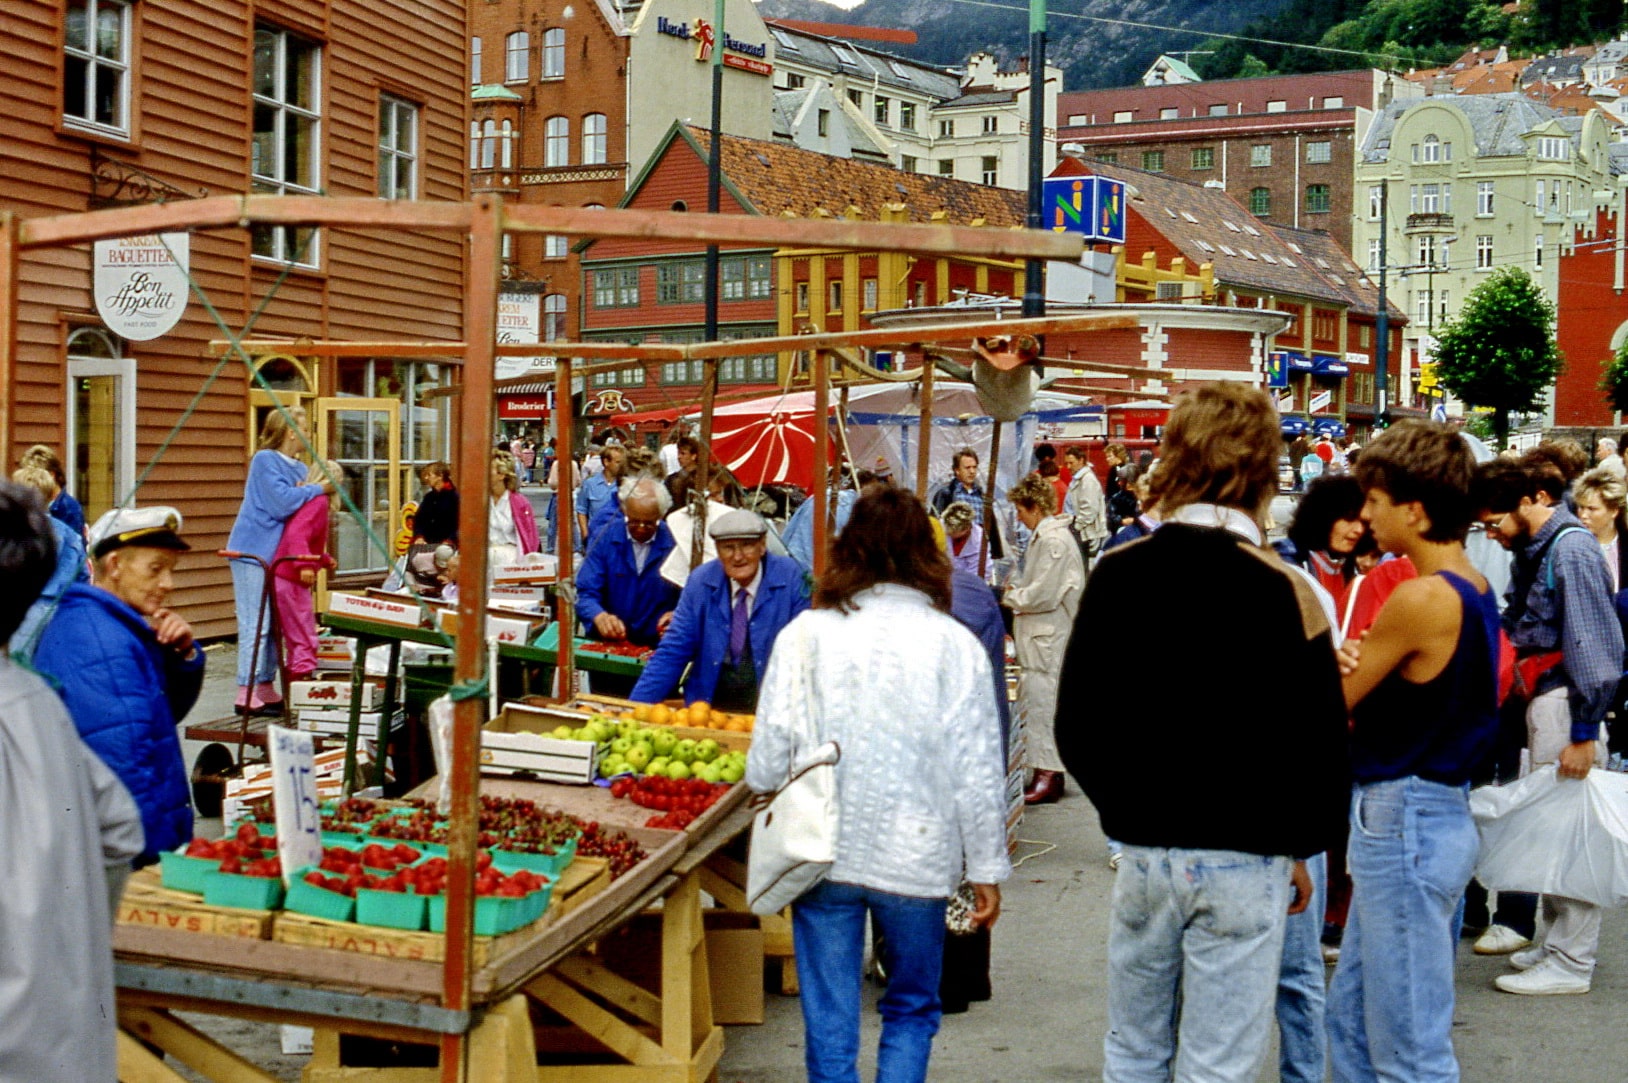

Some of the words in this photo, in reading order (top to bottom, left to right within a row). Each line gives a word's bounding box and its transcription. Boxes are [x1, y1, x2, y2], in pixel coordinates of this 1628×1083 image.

[109, 249, 174, 262] BAGUETTER
[130, 271, 162, 293] Bon
[104, 283, 176, 317] Appetit
[507, 401, 546, 411] Broderier
[345, 597, 372, 608] TOTEN
